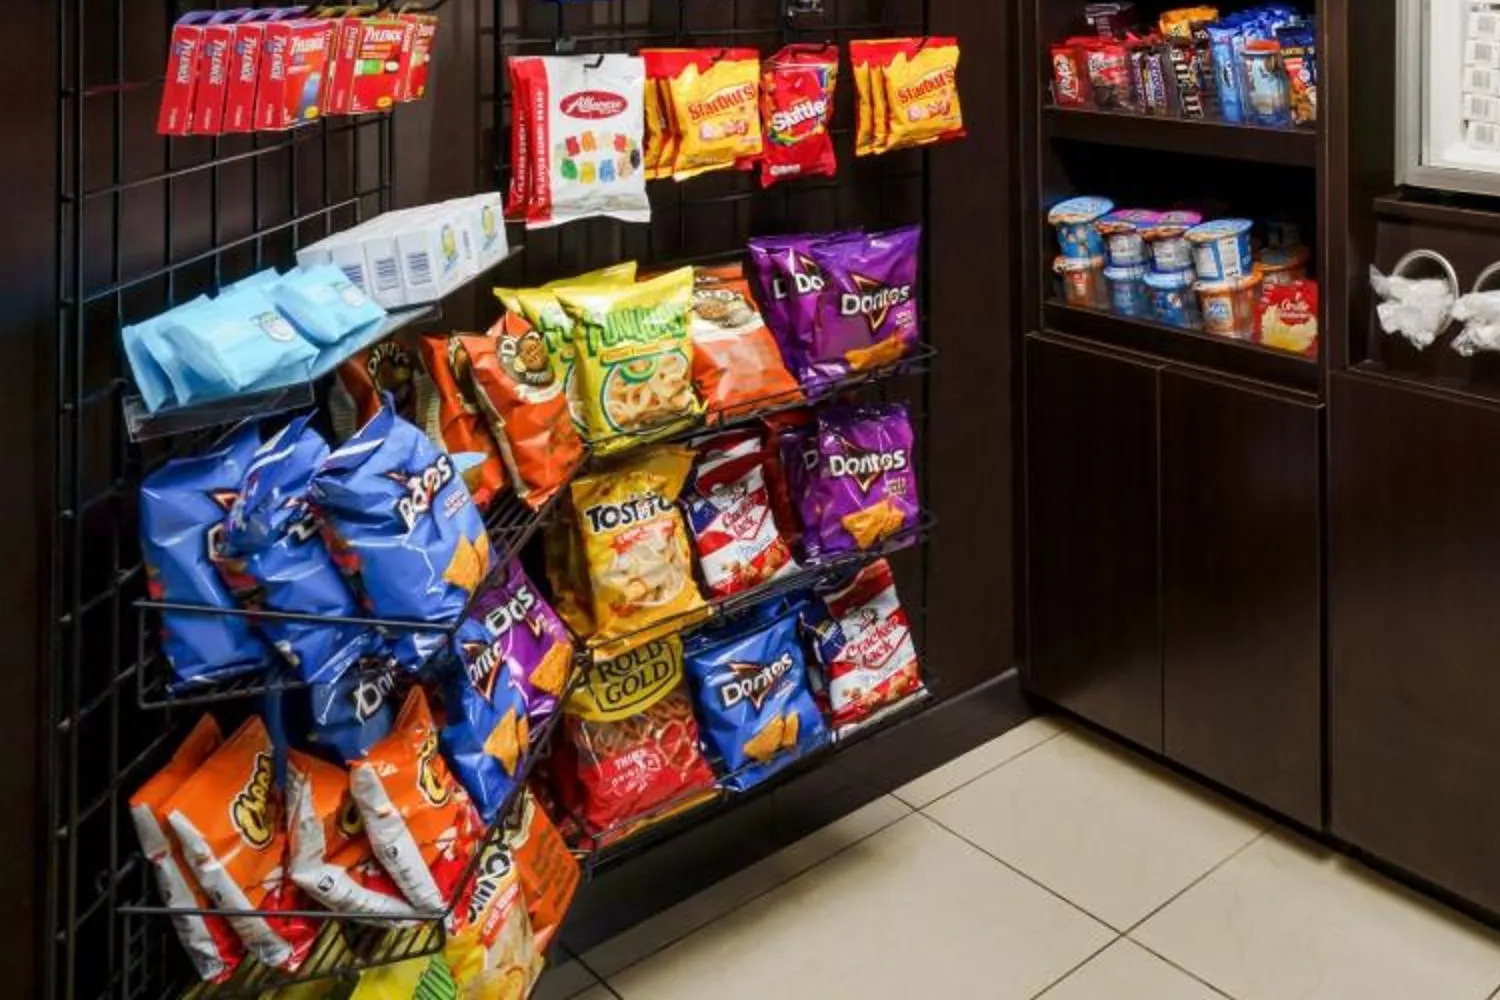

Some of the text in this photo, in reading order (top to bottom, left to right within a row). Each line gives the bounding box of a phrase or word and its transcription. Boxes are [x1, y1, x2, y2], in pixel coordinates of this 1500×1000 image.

[688, 84, 757, 120] Starburs
[771, 100, 828, 130] Skittle
[841, 284, 911, 316] Doritos
[829, 450, 906, 477] Doritos
[599, 640, 665, 684] ROLD
[720, 652, 793, 707] Doritos
[605, 659, 670, 706] GOLD
